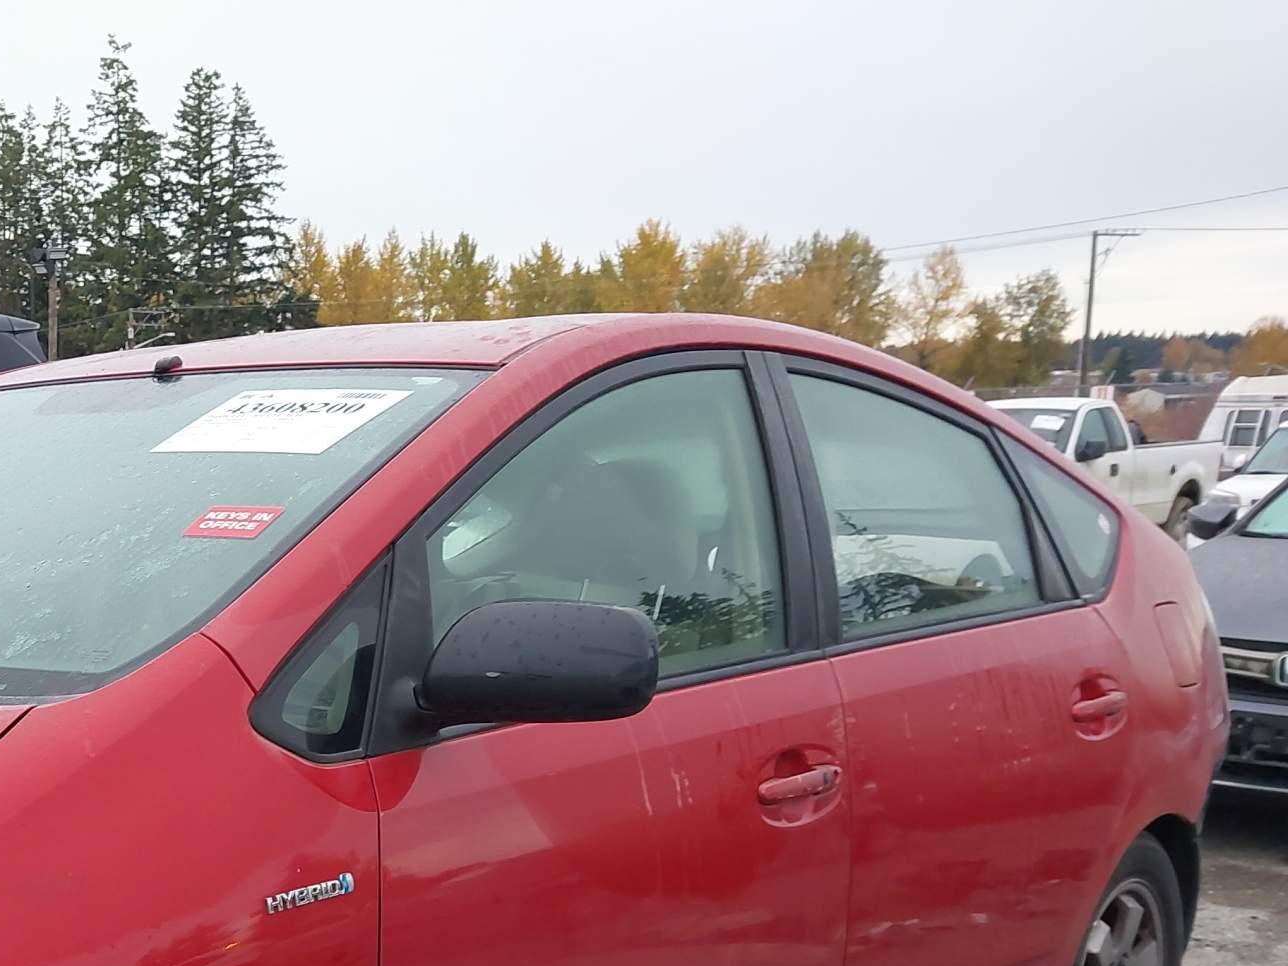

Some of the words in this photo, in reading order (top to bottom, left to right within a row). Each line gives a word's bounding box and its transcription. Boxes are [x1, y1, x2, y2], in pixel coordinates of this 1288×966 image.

[227, 402, 366, 415] 43608200
[204, 511, 250, 520] KEYS
[252, 512, 273, 521] IN
[199, 521, 260, 530] OFFICE
[266, 880, 344, 914] HYBRID
